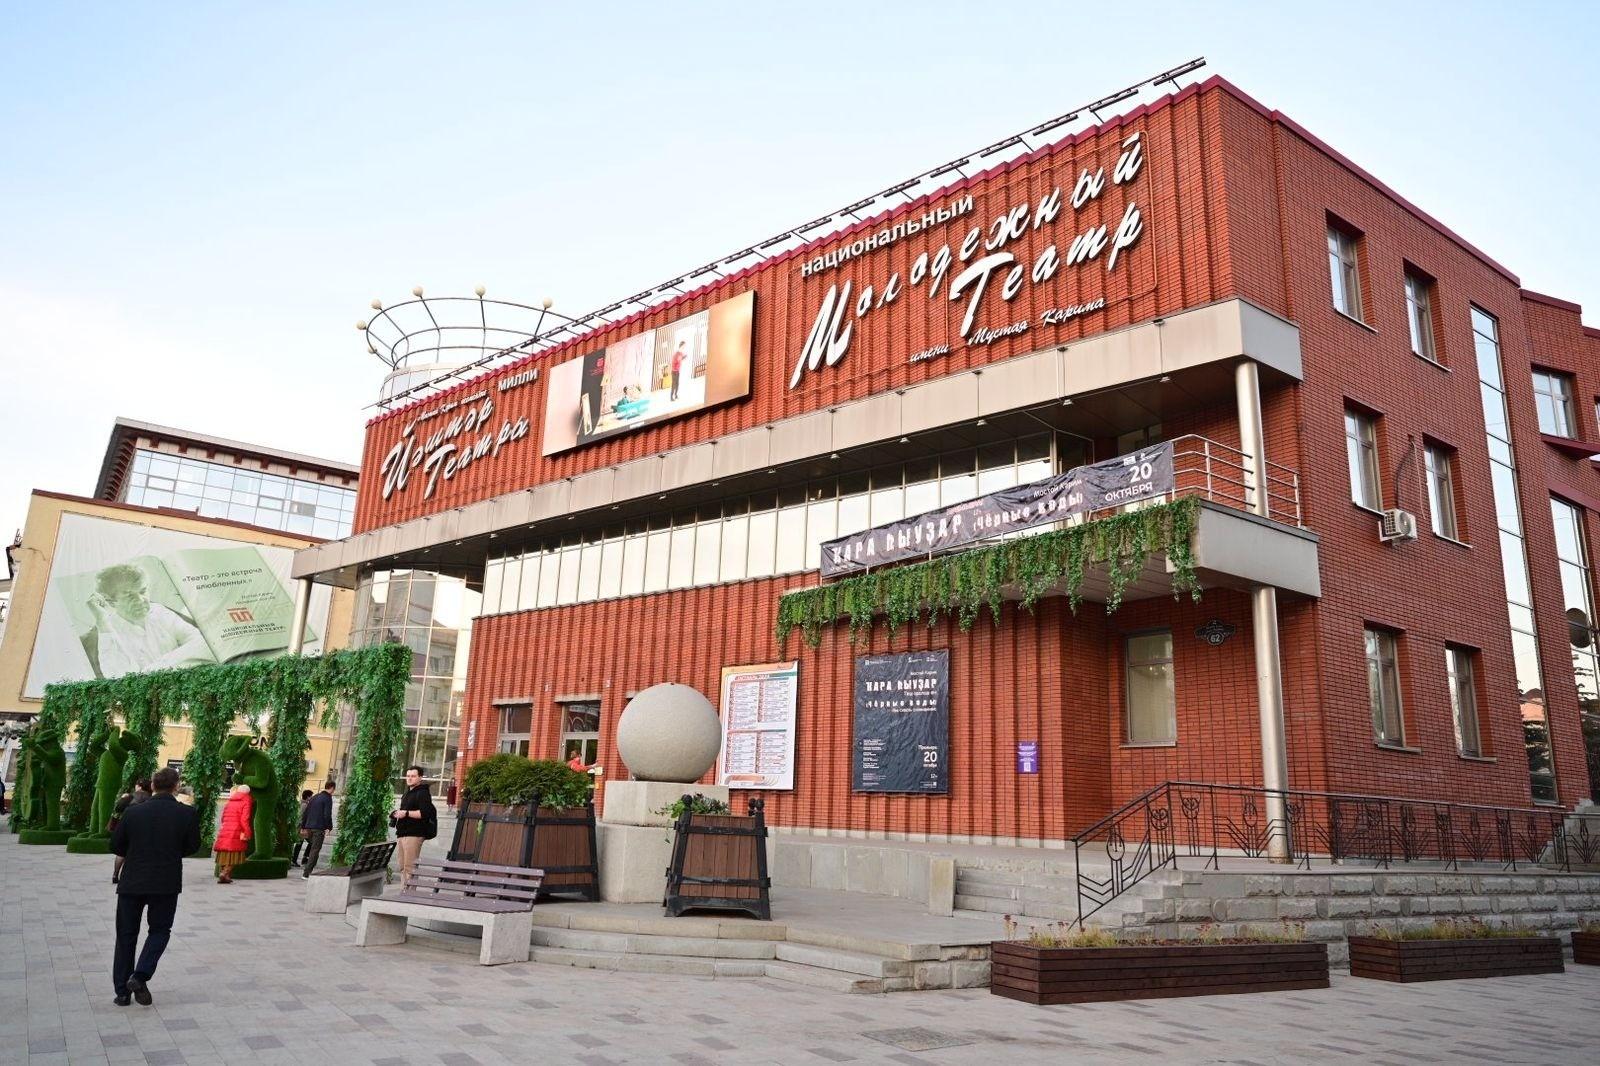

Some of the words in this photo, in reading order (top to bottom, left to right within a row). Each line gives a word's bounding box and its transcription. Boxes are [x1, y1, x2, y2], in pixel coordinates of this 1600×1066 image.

[789, 131, 1144, 390] Молодежный
[801, 193, 975, 277] национальный
[948, 202, 1143, 338] Театр
[909, 343, 950, 364] имени
[968, 319, 1028, 346] Мустая
[1040, 297, 1105, 329] Карима
[1105, 483, 1153, 502] ОКТЯБРЯ
[1128, 462, 1153, 484] 20
[923, 751, 938, 763] 20
